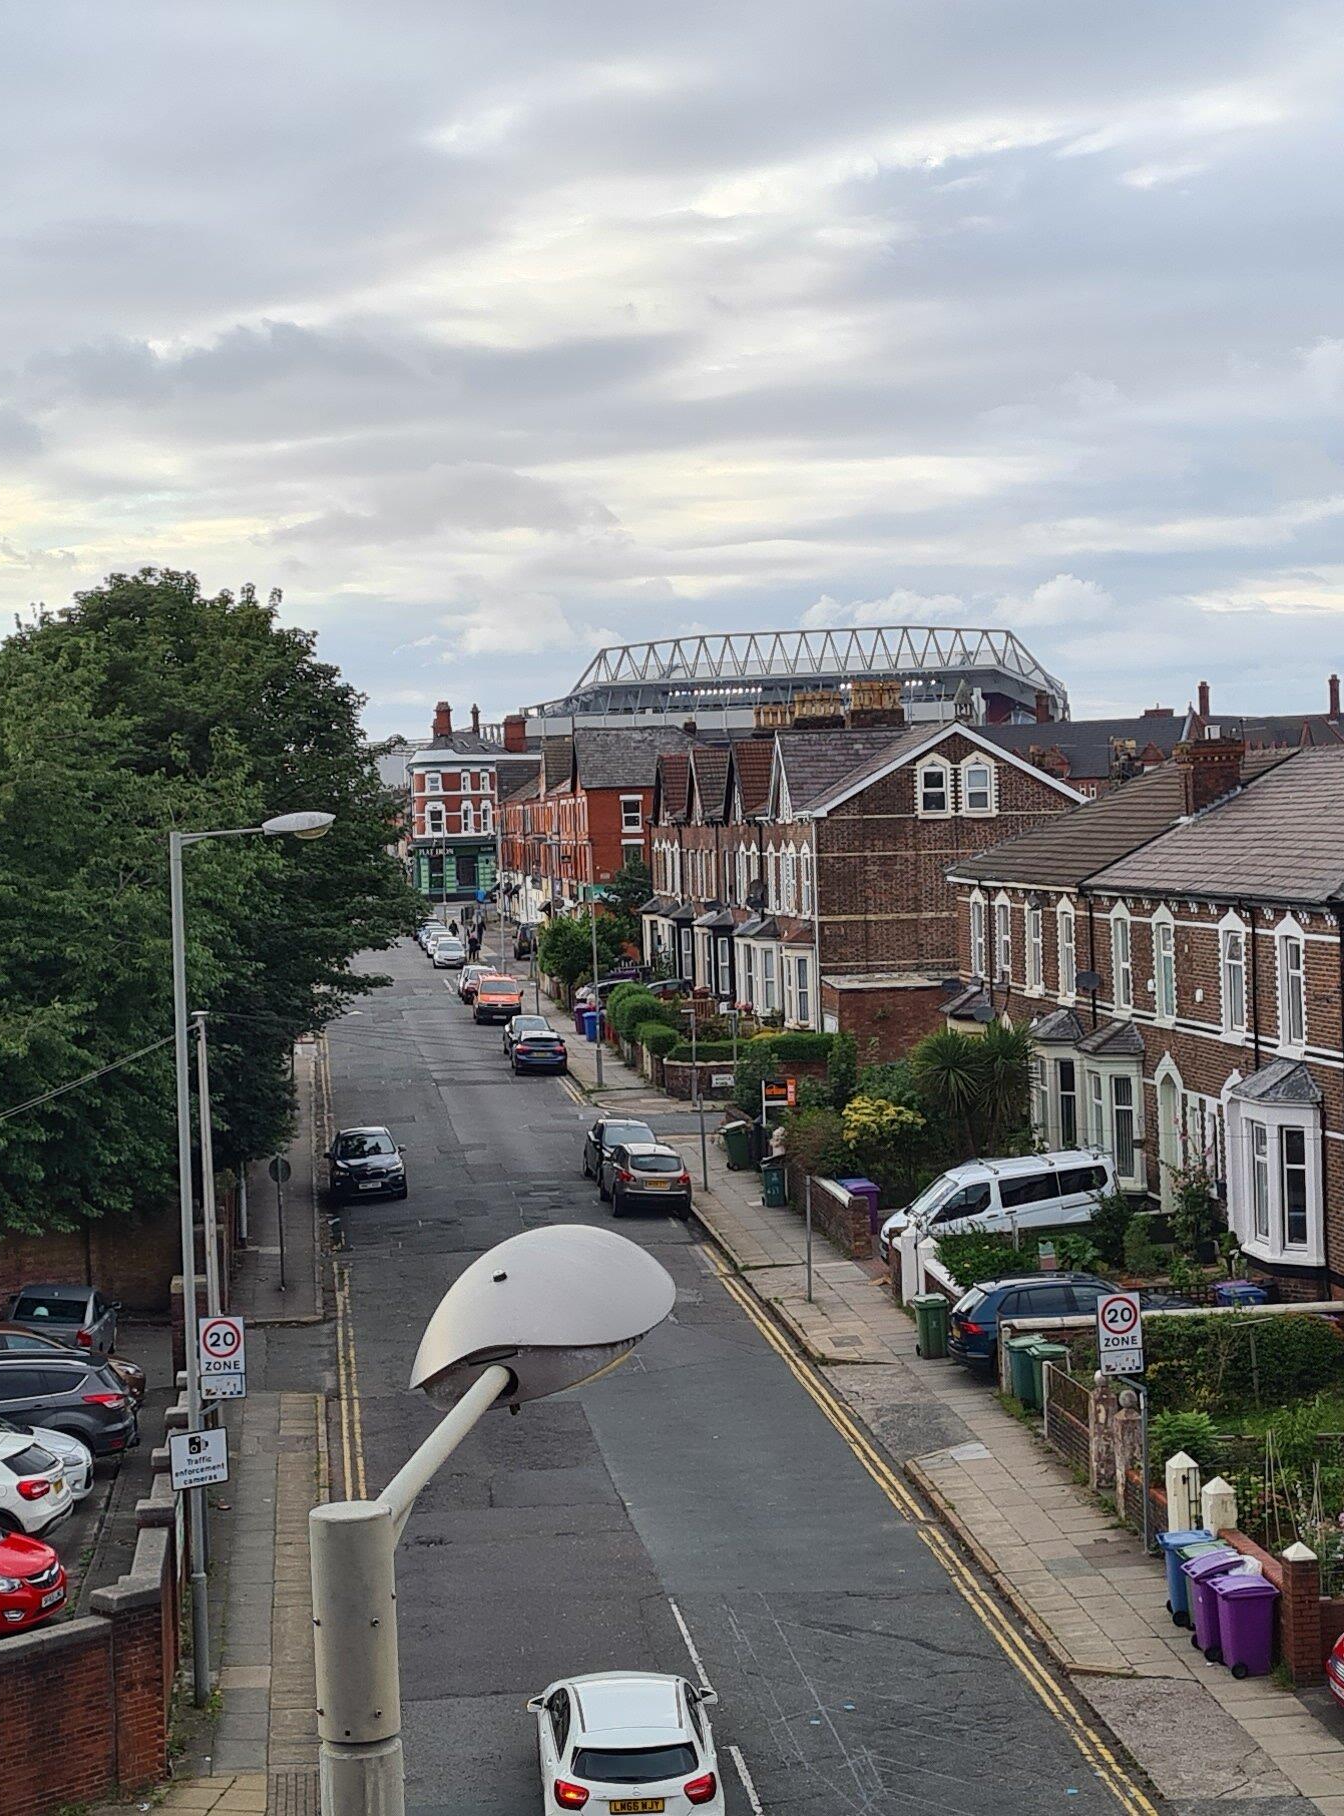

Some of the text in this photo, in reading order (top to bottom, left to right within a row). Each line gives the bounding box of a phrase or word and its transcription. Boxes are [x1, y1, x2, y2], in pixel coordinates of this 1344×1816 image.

[1107, 1307, 1132, 1323] 20
[209, 1331, 235, 1347] 20
[1104, 1336, 1138, 1347] ZONE
[205, 1360, 241, 1371] ZONE
[186, 1455, 212, 1465] Traffic
[175, 1462, 224, 1477] enforcement
[183, 1474, 218, 1485] cameras
